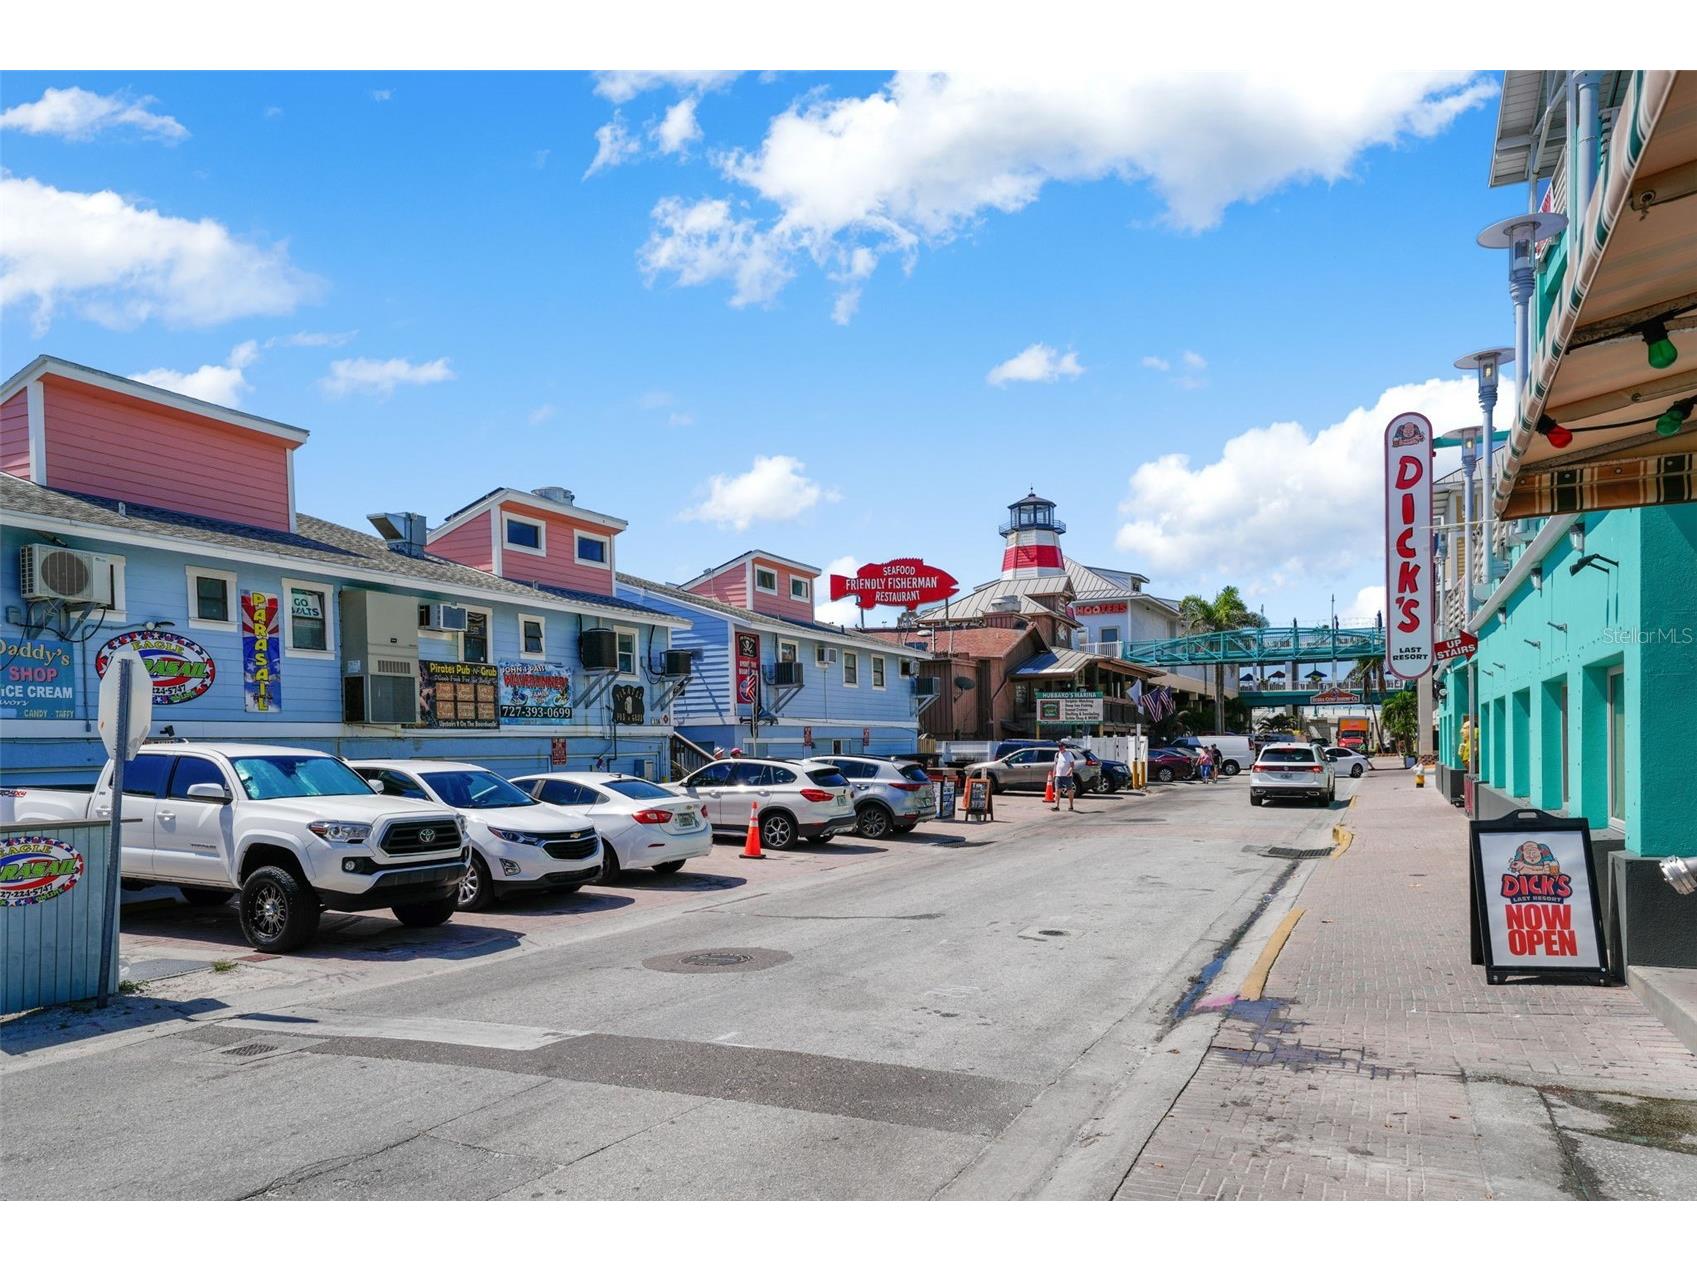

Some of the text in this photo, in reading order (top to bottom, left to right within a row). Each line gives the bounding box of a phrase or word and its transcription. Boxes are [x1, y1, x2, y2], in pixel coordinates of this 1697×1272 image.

[1395, 455, 1424, 634] DICK'S
[883, 565, 916, 576] SEAFOOD
[845, 576, 937, 590] FRIENDLY FISHERMAN
[293, 598, 309, 607] GO
[875, 590, 920, 602] RESTAURANT
[1076, 602, 1128, 616] HOOTERS
[131, 640, 185, 655] EAGLE
[252, 592, 269, 711] PARASAIL
[1446, 639, 1462, 649] UP
[1437, 644, 1476, 660] STAIRS
[9, 666, 58, 682] SHOP
[430, 662, 455, 675] Pirates
[456, 665, 471, 676] Pub
[480, 666, 497, 677] Grub
[27, 685, 73, 698] CREAM
[24, 709, 48, 718] CANDY
[502, 706, 571, 718] 727-393-0699
[0, 857, 77, 881] RASAIL
[0, 882, 53, 898] 27-224-5747
[1502, 874, 1573, 898] DICK'S
[1505, 904, 1571, 930] NOW
[1508, 929, 1578, 956] OPEN
